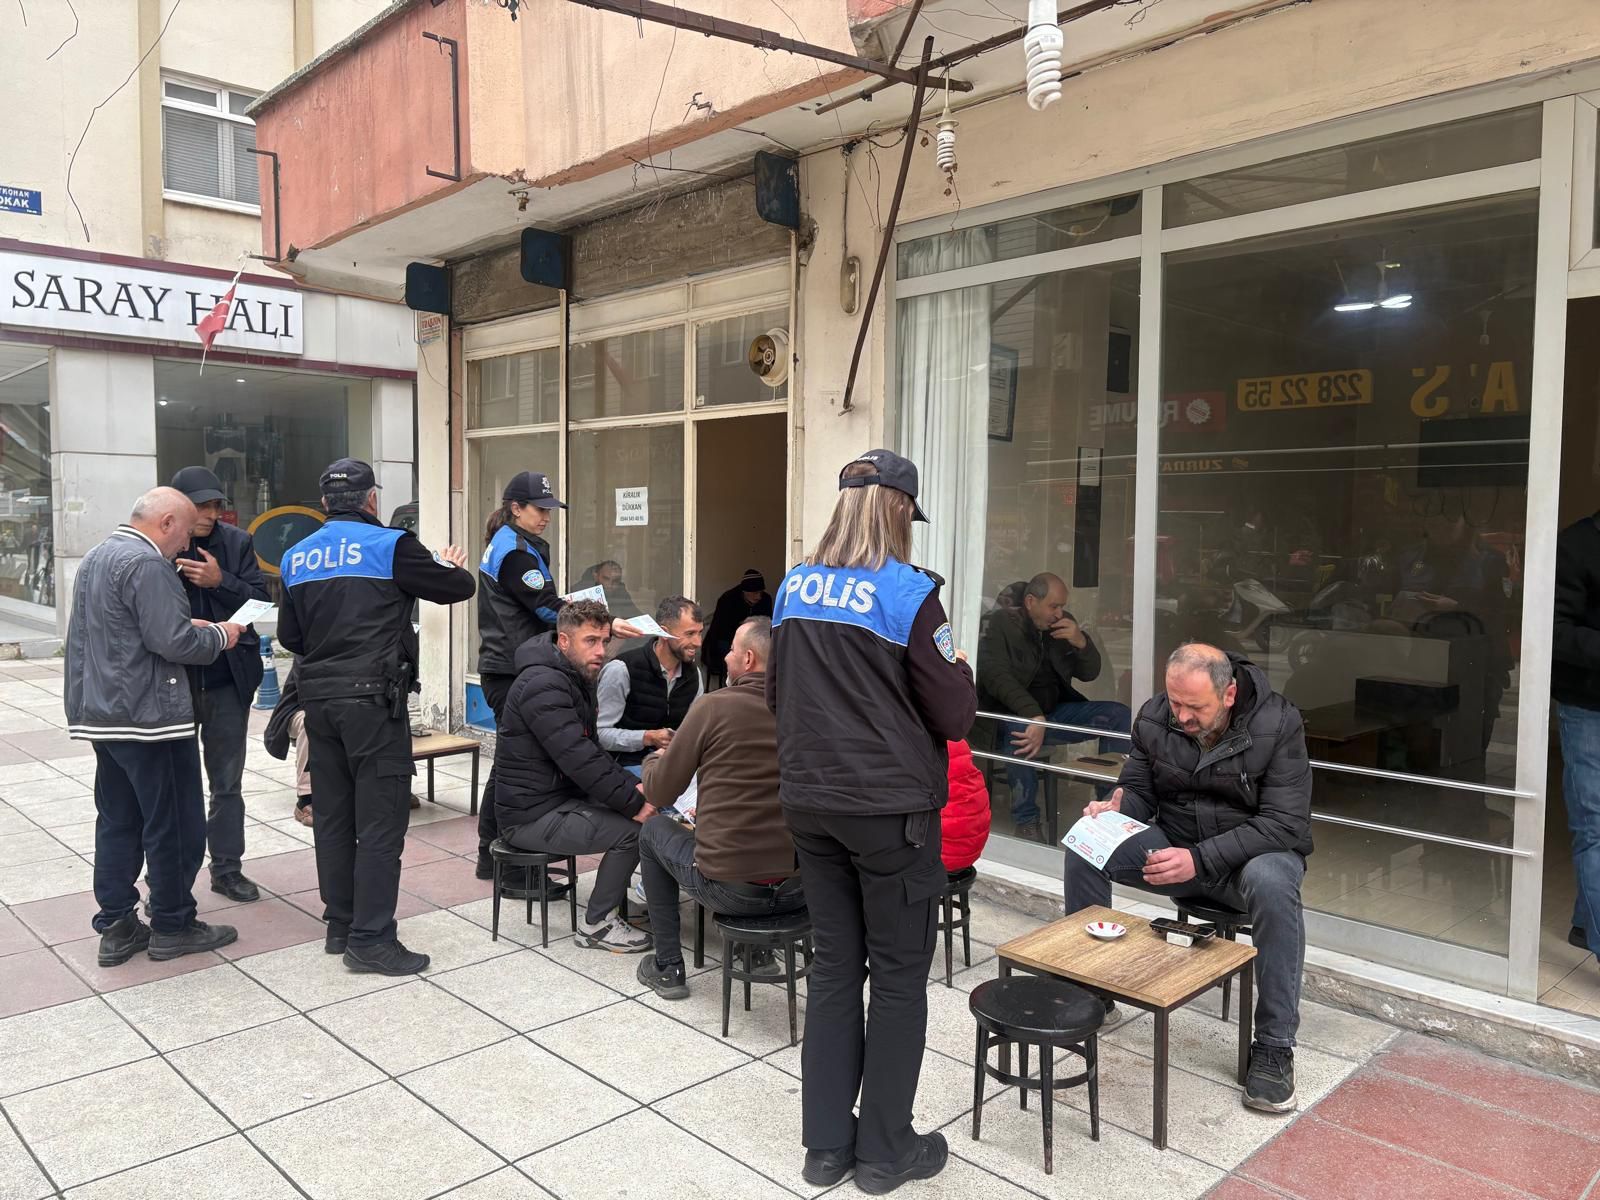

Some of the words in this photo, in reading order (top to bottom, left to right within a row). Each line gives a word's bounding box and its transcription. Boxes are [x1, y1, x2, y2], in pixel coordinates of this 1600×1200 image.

[12, 269, 172, 322] SARAY
[185, 290, 293, 338] HALI
[291, 538, 362, 575] POLİS
[784, 572, 876, 614] POLİS
